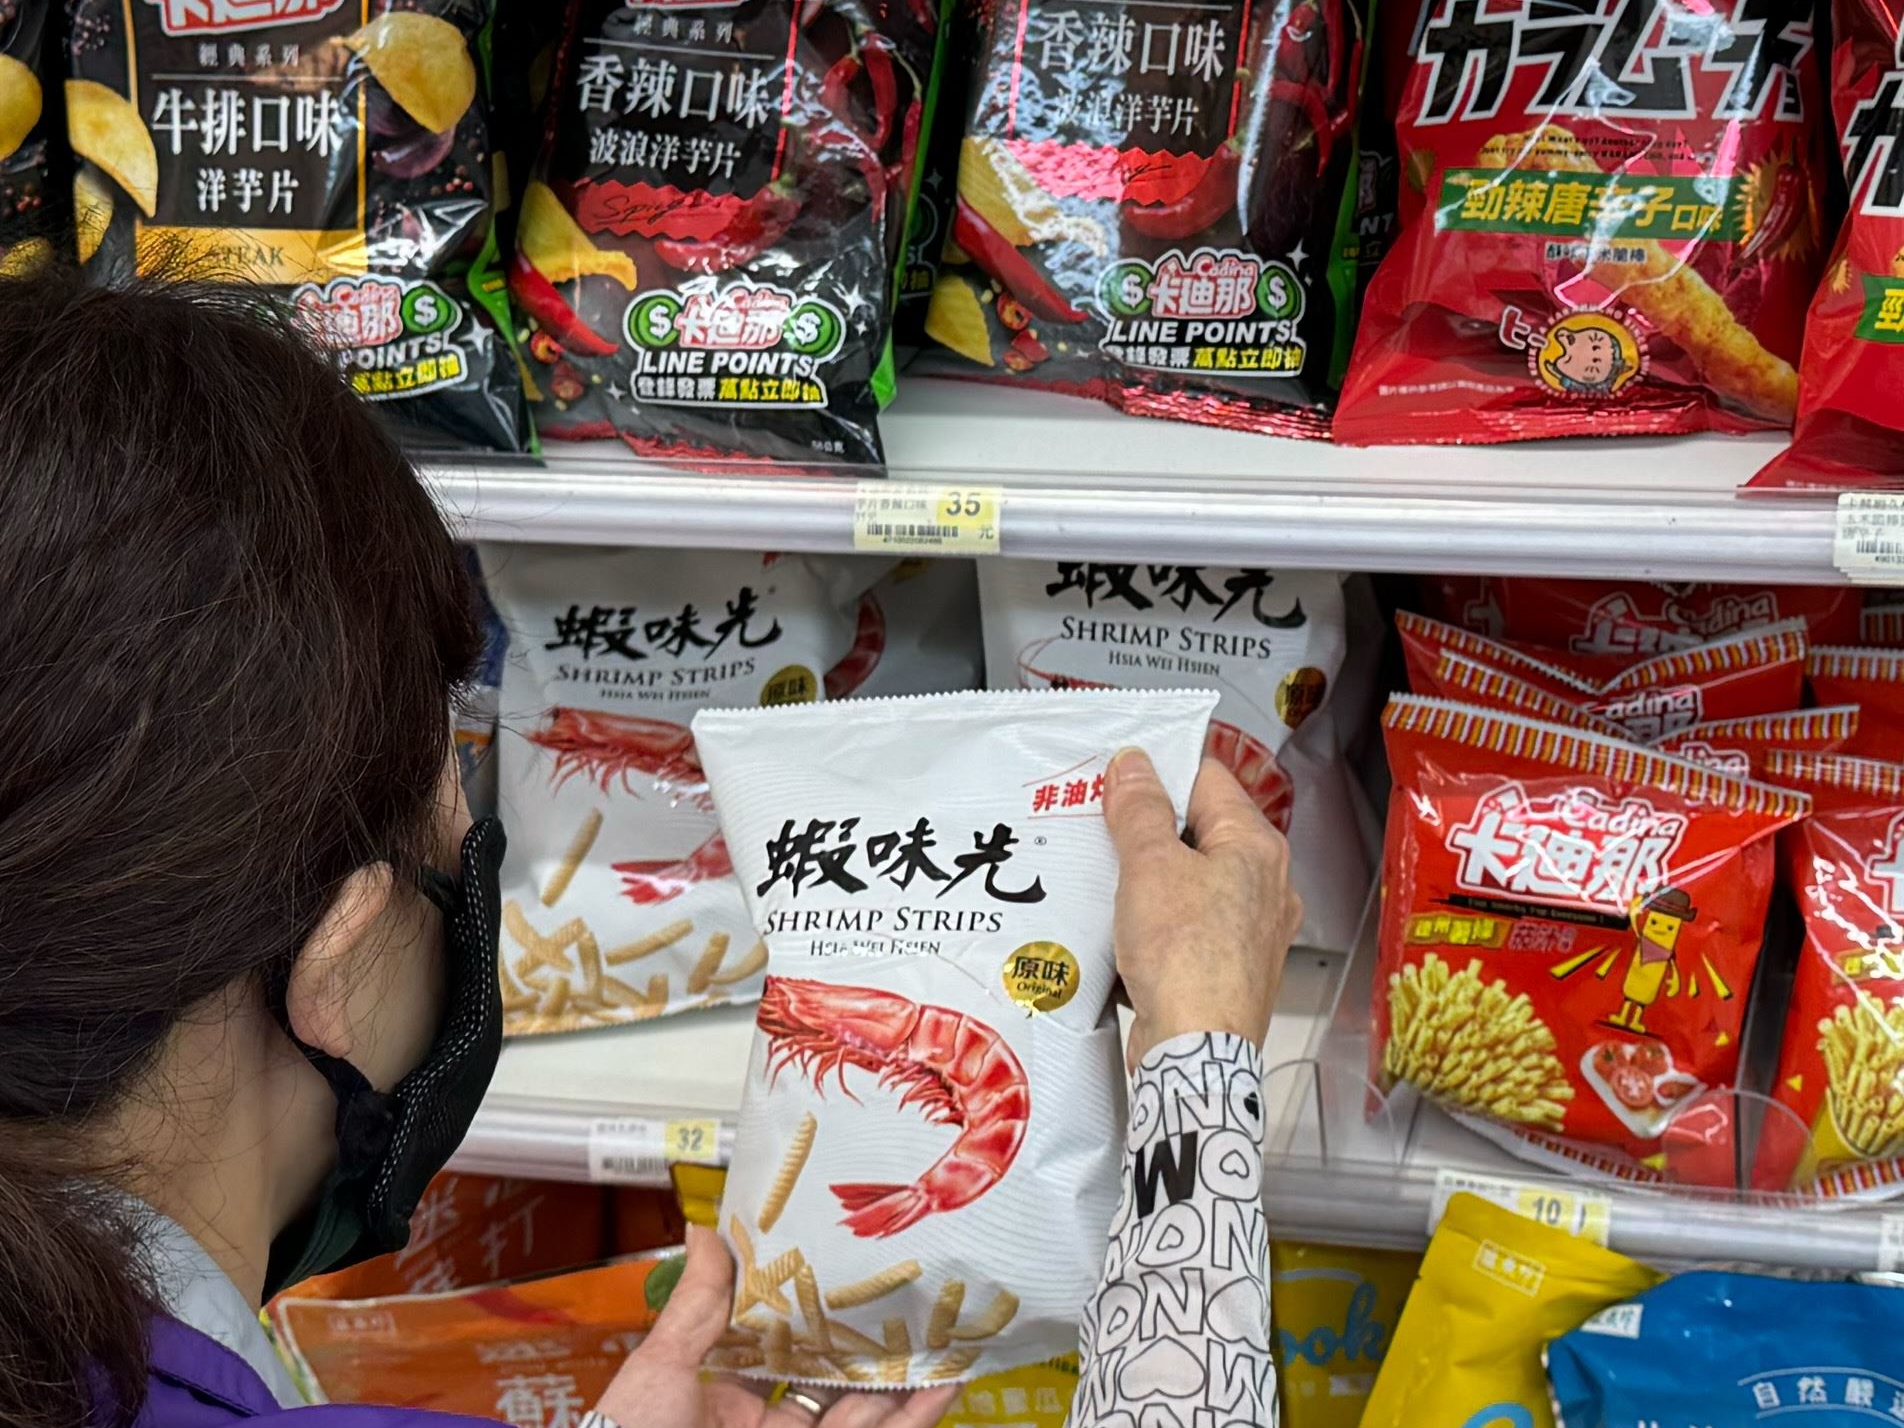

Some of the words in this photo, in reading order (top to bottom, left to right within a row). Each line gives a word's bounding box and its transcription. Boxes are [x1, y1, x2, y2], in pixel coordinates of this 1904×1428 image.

[199, 42, 301, 69] 經典系列
[1038, 9, 1228, 82] 香辣口味
[577, 54, 771, 130] 香辣口味
[152, 88, 340, 157] 牛排口味
[588, 128, 742, 179] 波浪洋芋片
[197, 168, 300, 214] 洋芋片
[1462, 179, 1726, 233] 勁辣唐辛子口味
[1149, 272, 1254, 319] 卡迪那
[1111, 322, 1176, 344] LINE
[1185, 317, 1298, 342] POINTS
[643, 351, 705, 375] LINE
[709, 351, 816, 376] POINTS
[945, 492, 982, 518] 35
[545, 586, 784, 663] 蝦味先
[1061, 617, 1170, 650] SHRIMP
[1181, 626, 1274, 661] STRIPS
[555, 662, 663, 688] SHRIMP
[669, 657, 757, 686] STRIPS
[1108, 650, 1142, 668] HSIA
[1145, 654, 1174, 671] WEI
[1177, 658, 1221, 676] HSIEN
[637, 687, 662, 702] WEI
[757, 815, 1048, 904] 蝦味先
[1452, 819, 1670, 902] 卡迪那
[763, 908, 884, 935] SHRIMP
[893, 905, 1004, 934] STRIPS
[1010, 956, 1071, 986] 原味
[1015, 981, 1063, 1002] Original
[676, 1127, 705, 1152] 32
[1533, 1197, 1562, 1227] 10
